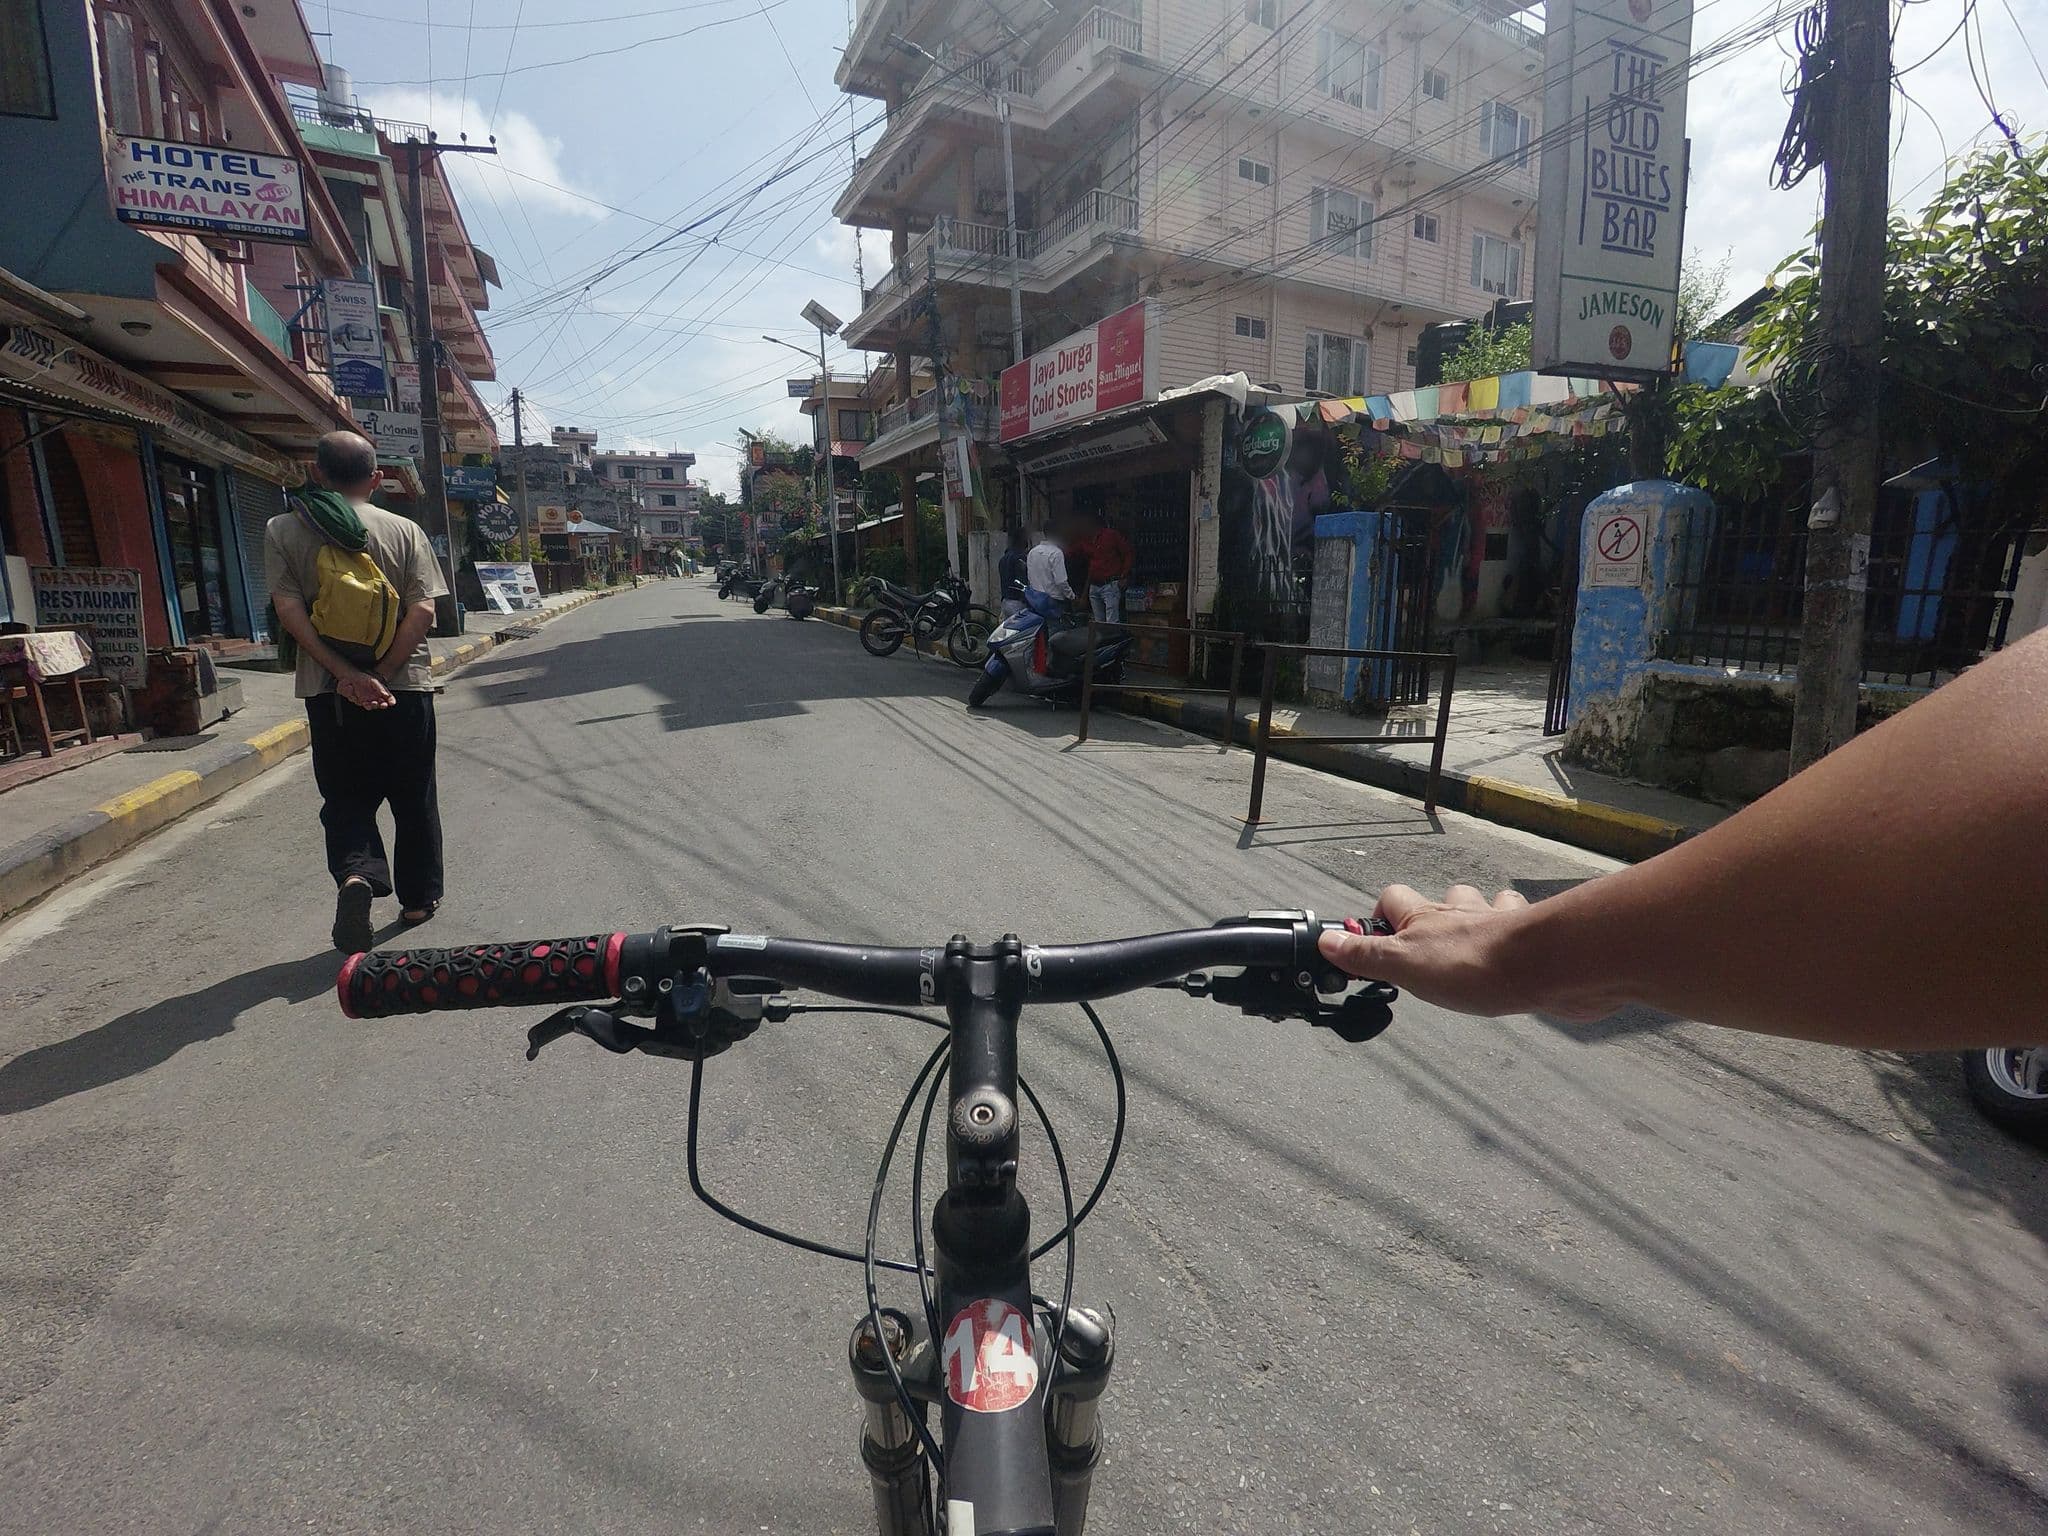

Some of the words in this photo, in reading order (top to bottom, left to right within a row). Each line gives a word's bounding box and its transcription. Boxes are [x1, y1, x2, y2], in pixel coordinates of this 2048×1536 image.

[1611, 49, 1662, 103] THE
[1608, 103, 1660, 151] OLD
[131, 142, 276, 180] HOTEL
[1591, 148, 1671, 203] BLUES
[122, 170, 146, 184] THE
[148, 170, 251, 196] TRANS
[117, 187, 300, 225] HIMALAYAN
[1602, 201, 1657, 250] BAR
[334, 294, 367, 305] SWISS
[1579, 291, 1665, 329] JAMESON
[1033, 360, 1055, 387] Jaya
[1057, 342, 1093, 376] Durga
[1099, 371, 1114, 385] San
[1114, 354, 1143, 381] Miguel
[1032, 388, 1055, 417] Cold
[1056, 377, 1094, 408] Stores
[1087, 444, 1113, 457] STORE
[478, 503, 514, 519] HOTEL
[479, 525, 518, 541] MONILA
[40, 590, 138, 609] RESTAURANT
[46, 613, 136, 625] SANDWICH
[942, 1314, 1034, 1393] 14
